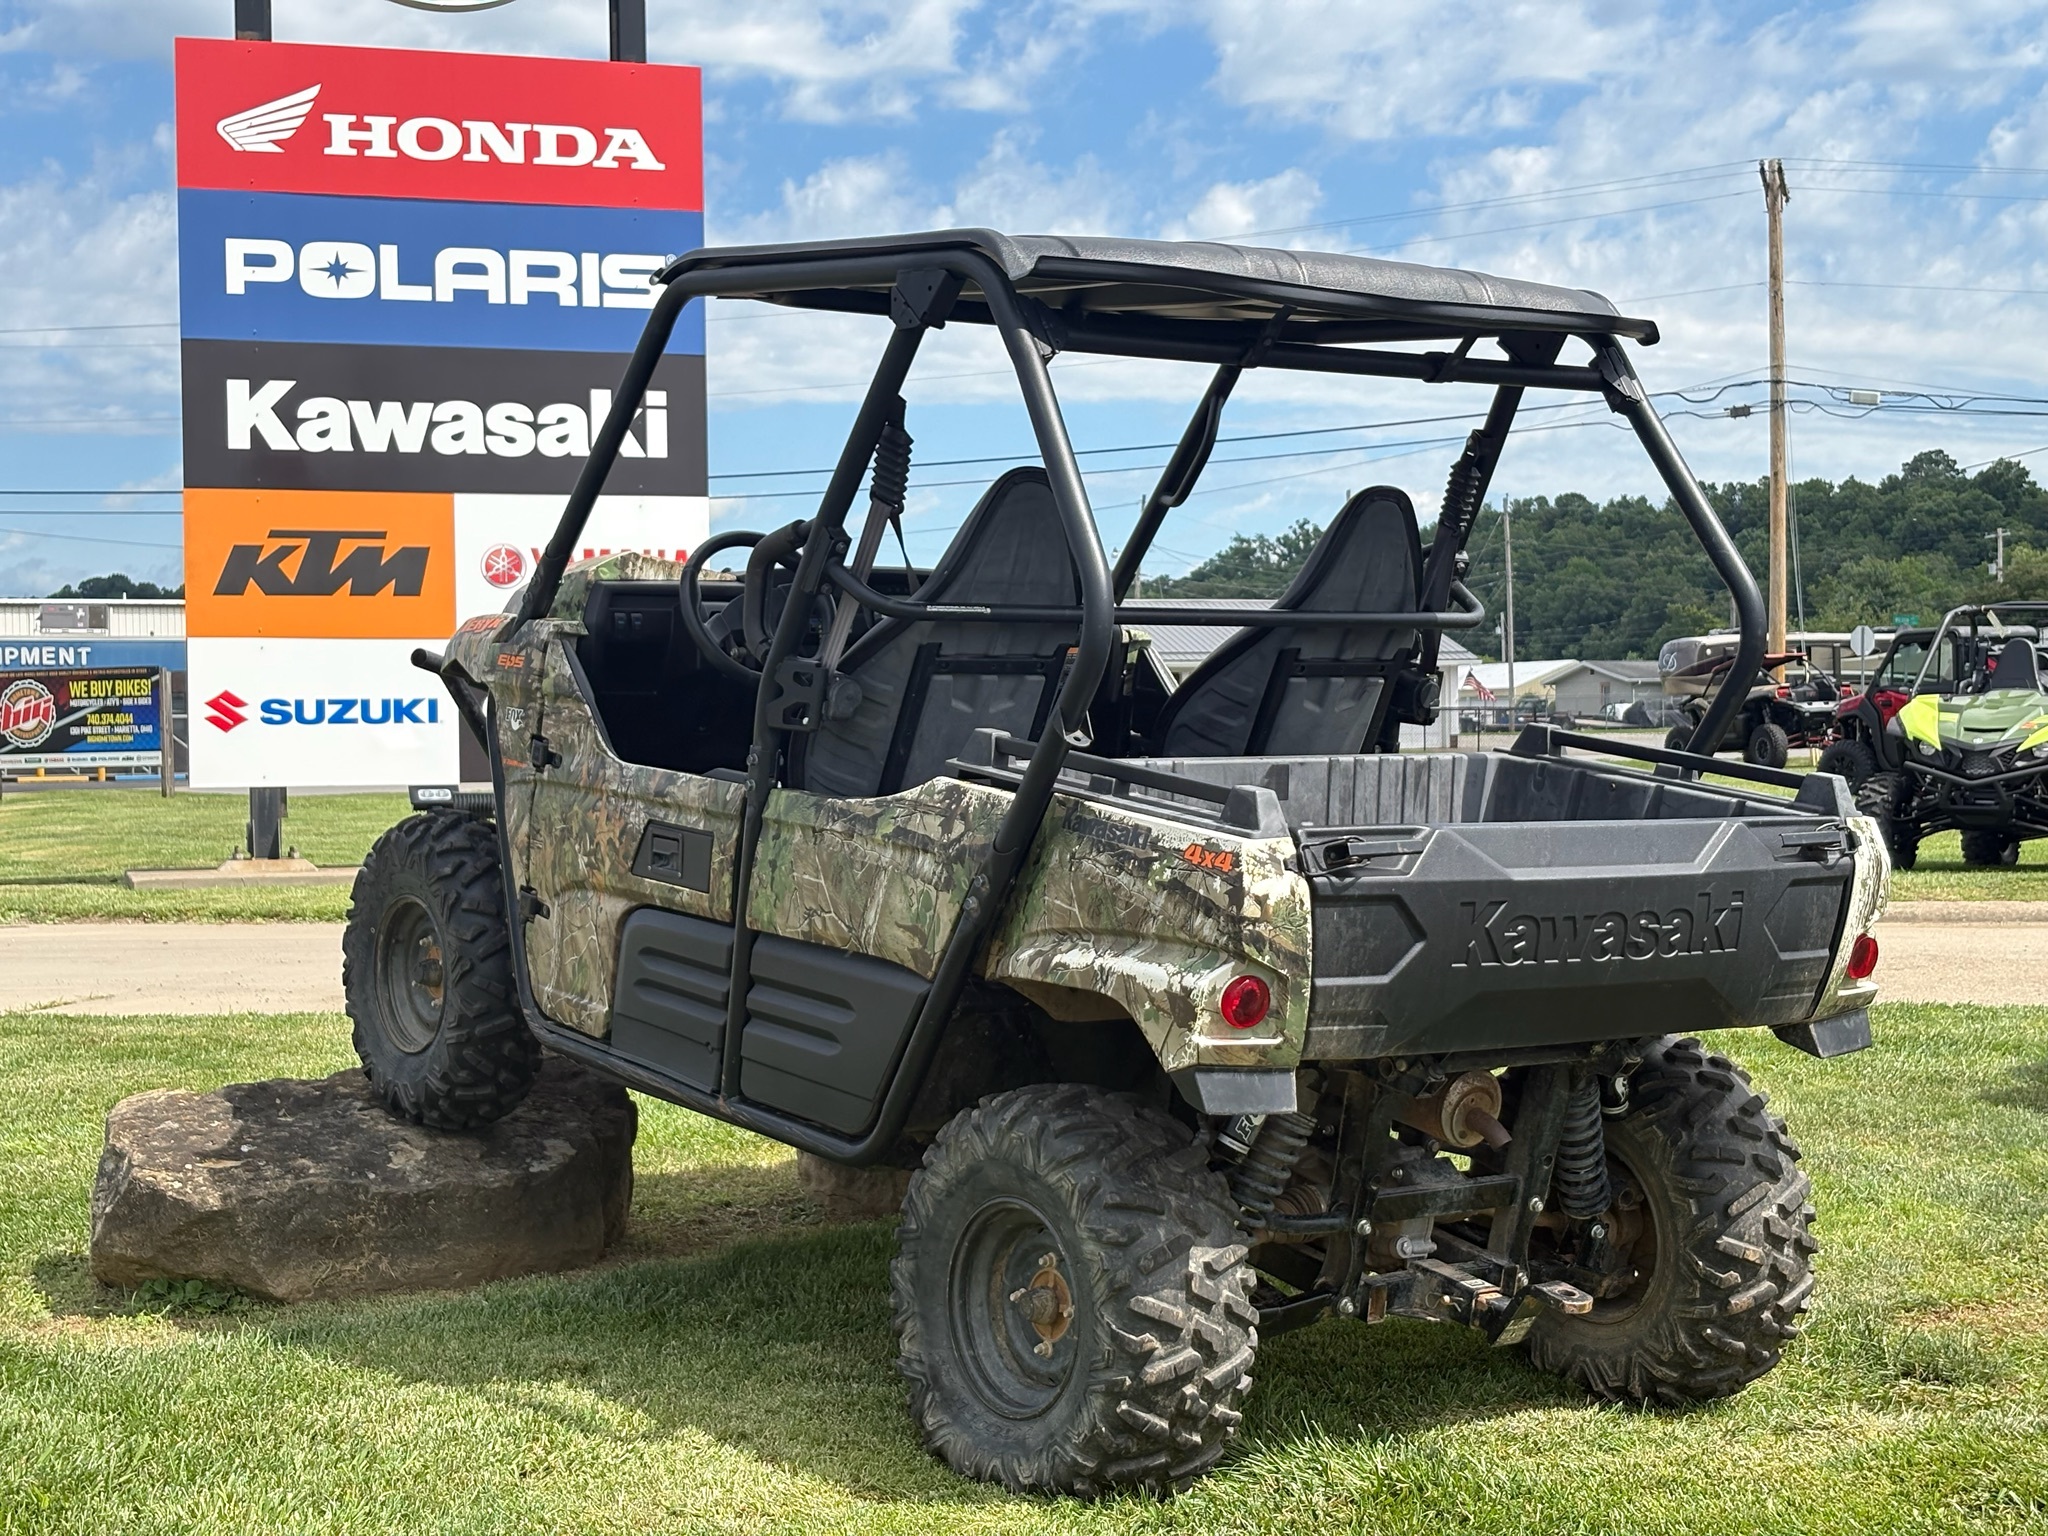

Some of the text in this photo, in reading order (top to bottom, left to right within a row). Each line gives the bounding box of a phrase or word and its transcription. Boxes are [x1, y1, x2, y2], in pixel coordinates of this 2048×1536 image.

[322, 113, 666, 171] HONDA
[224, 237, 668, 309] POLARIS
[213, 529, 430, 597] KTM
[69, 679, 152, 698] WE BUY BIKES!
[259, 697, 439, 725] SUZUKI
[87, 713, 134, 725] 740.374.4044
[1062, 801, 1152, 850] Kawasaki
[1183, 843, 1233, 873] 4x4
[1451, 890, 1745, 967] Kawasaki
